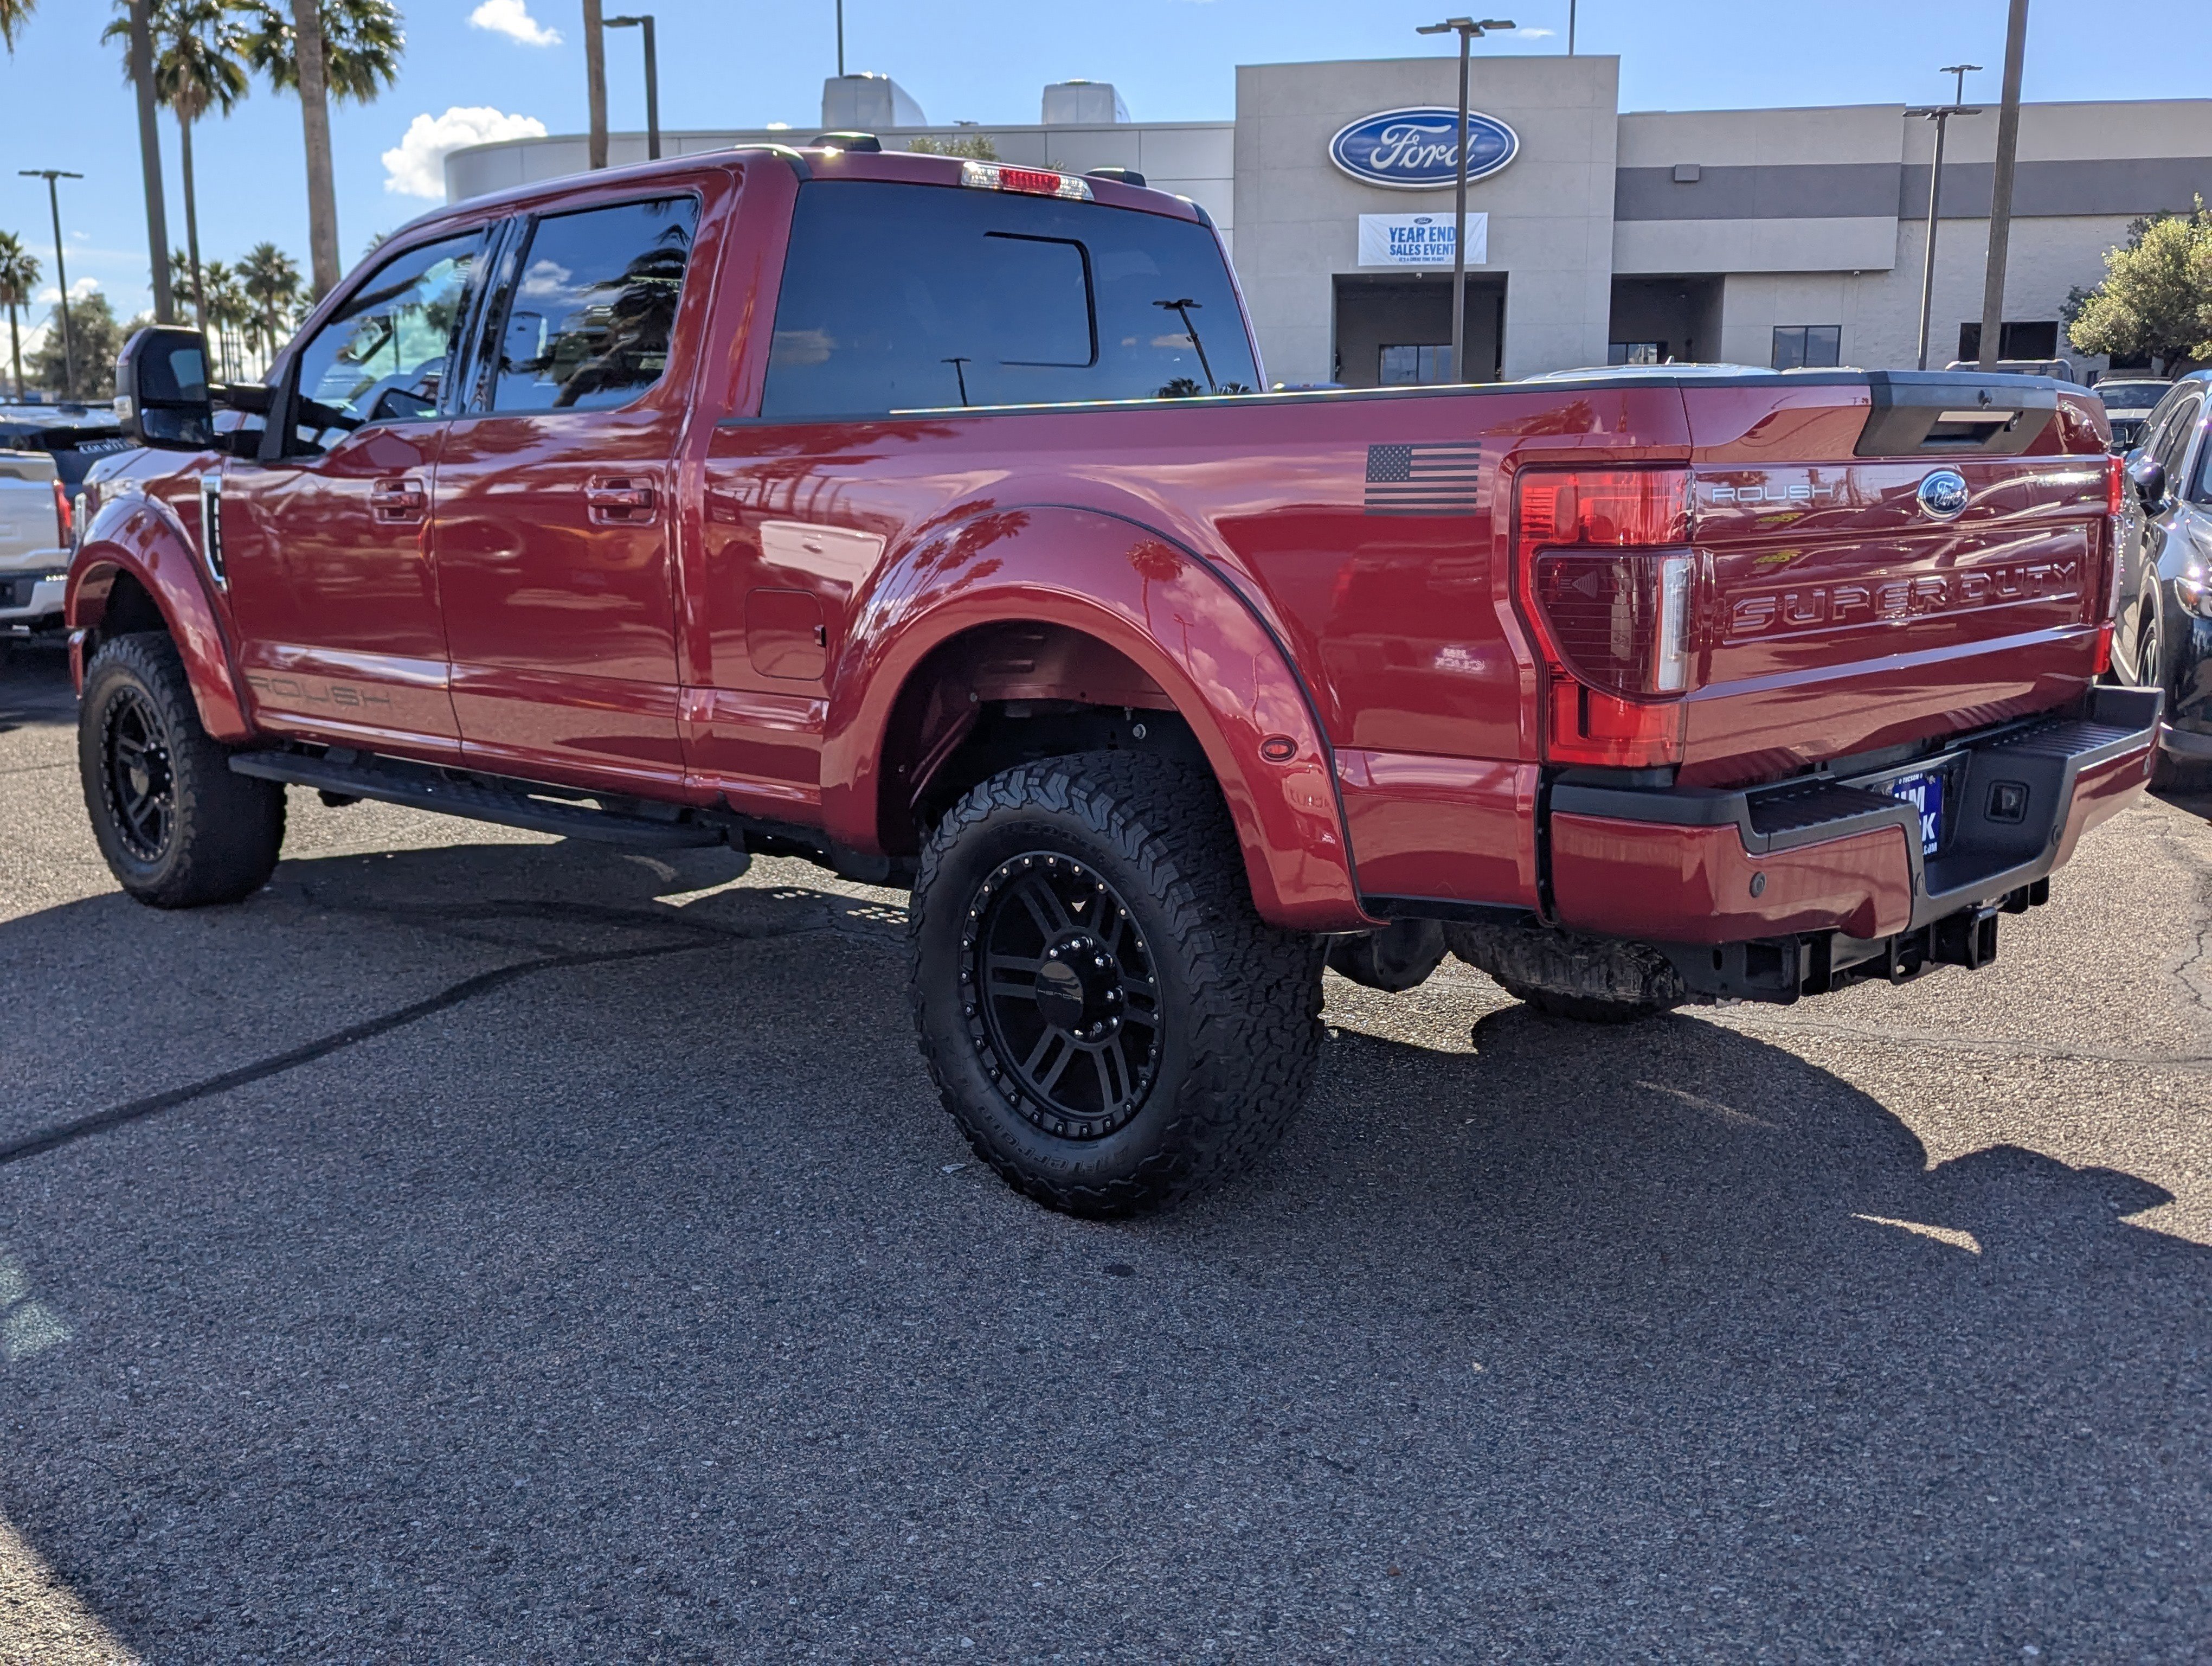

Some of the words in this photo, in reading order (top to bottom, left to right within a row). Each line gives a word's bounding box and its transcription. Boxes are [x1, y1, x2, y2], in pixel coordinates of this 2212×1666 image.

[1370, 124, 1478, 169] Ford
[1388, 227, 1425, 242] YEAR
[1429, 227, 1456, 242] END
[1390, 244, 1421, 255] SALES
[1424, 244, 1456, 255] EVENT
[1712, 484, 1834, 503] ROUSH
[1934, 480, 1962, 507] Ford
[1731, 575, 1949, 634] SUPER
[1959, 561, 2076, 605] DUTY
[246, 675, 393, 709] ROUSH
